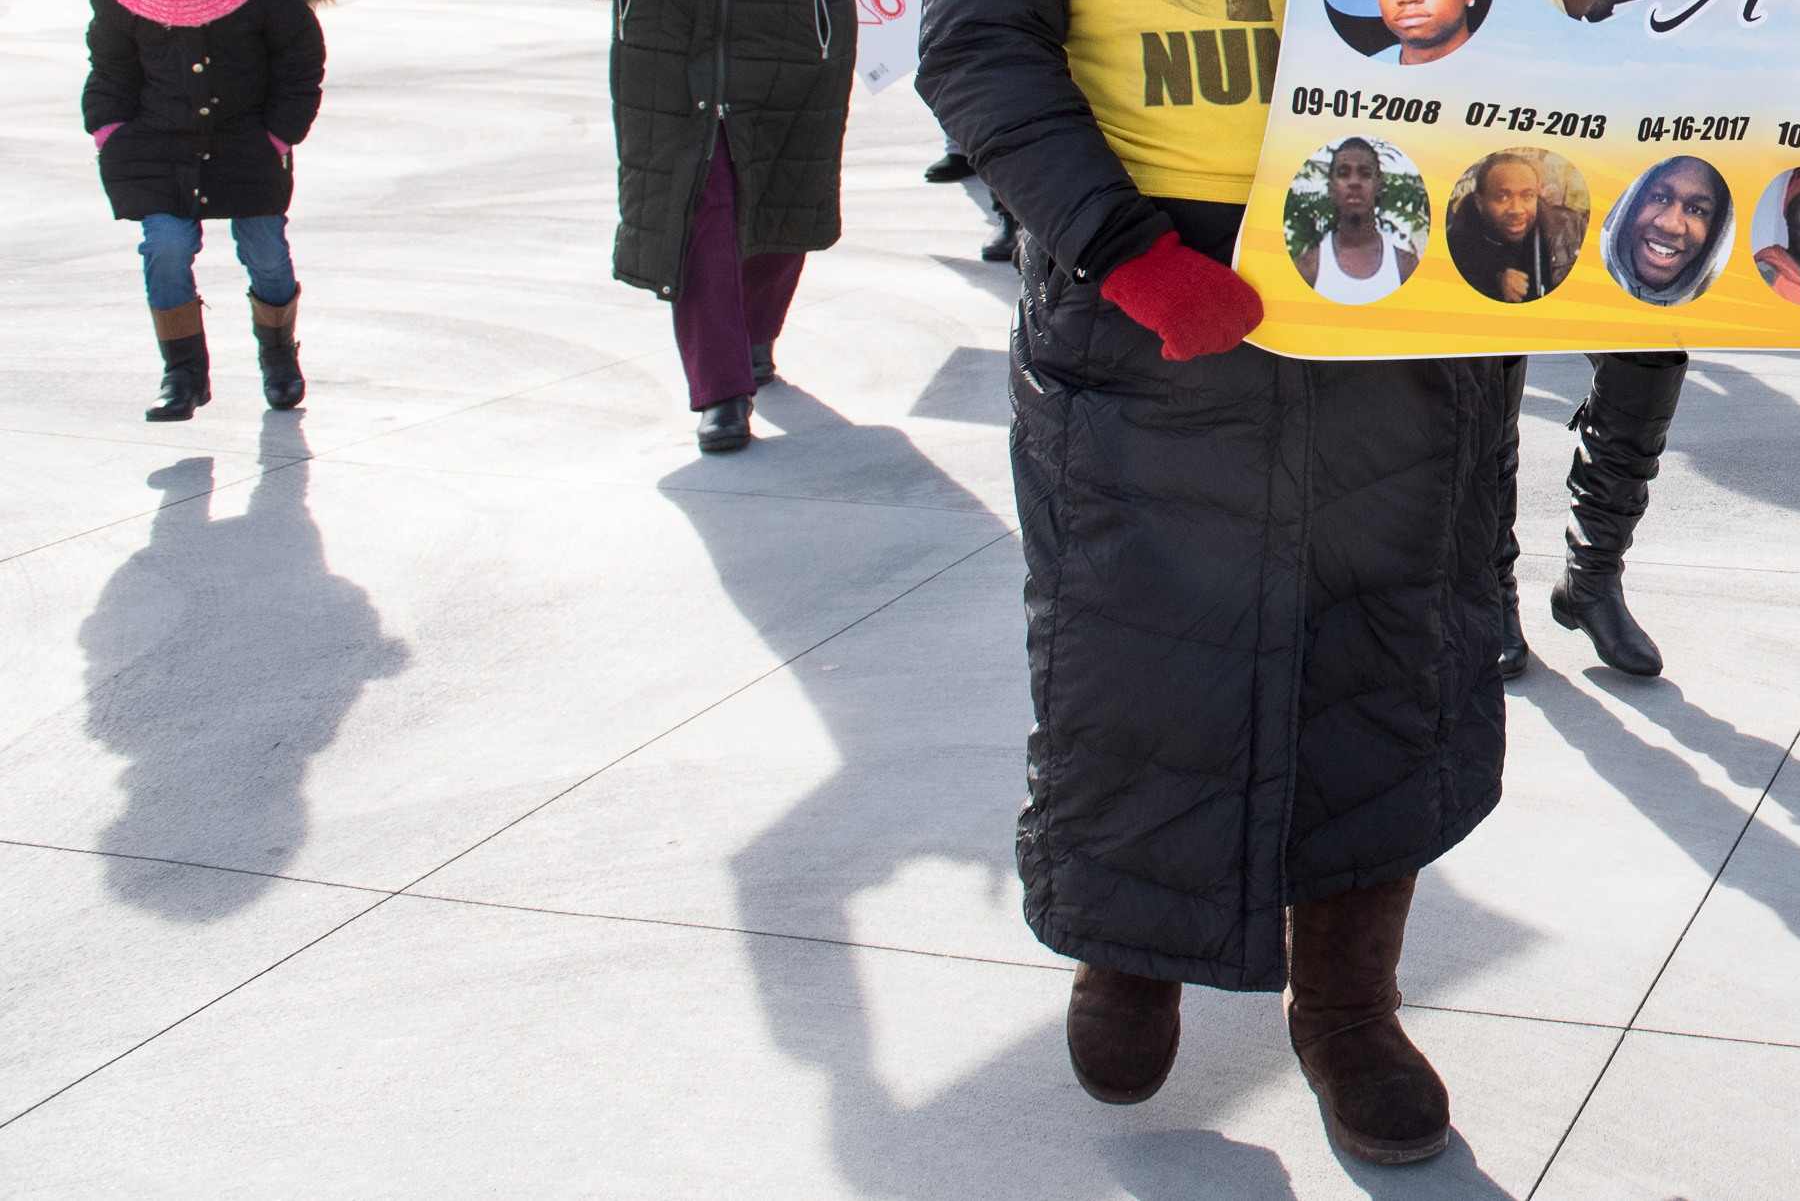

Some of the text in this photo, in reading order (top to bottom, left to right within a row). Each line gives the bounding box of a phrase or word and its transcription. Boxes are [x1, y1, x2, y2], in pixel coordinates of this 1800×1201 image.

[1291, 85, 1441, 125] 09-01-2008
[1465, 101, 1607, 140] 07-13-2013
[1637, 115, 1750, 142] 04-16-2017
